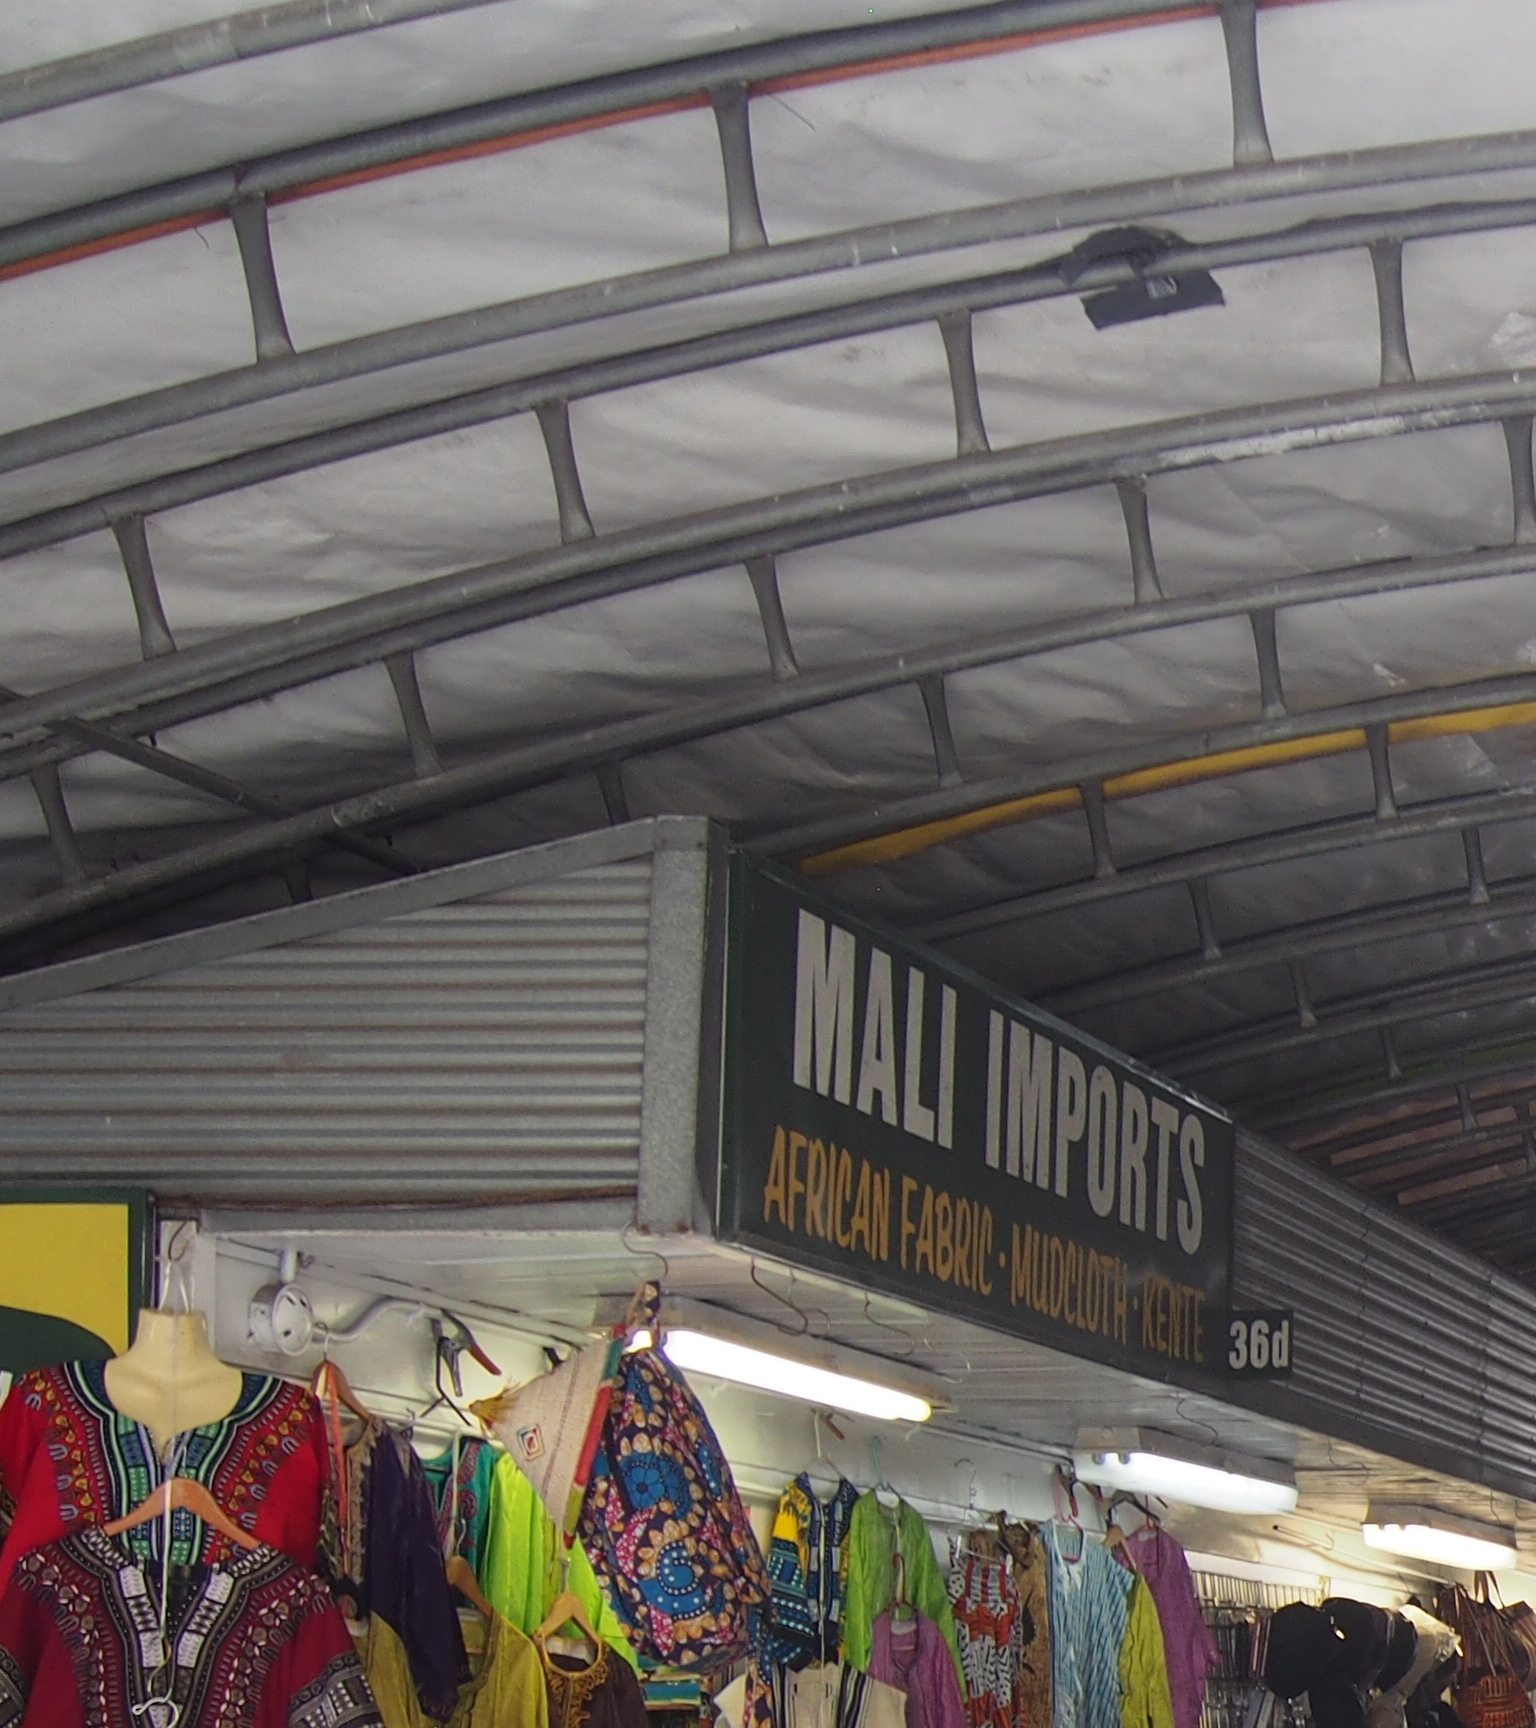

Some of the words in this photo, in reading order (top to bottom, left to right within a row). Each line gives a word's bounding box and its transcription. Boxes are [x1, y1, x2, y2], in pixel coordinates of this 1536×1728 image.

[794, 907, 957, 1150] MALI
[985, 1008, 1205, 1256] IMPORTS
[763, 1124, 891, 1262] AFRICAN
[901, 1175, 994, 1297] FABRIC
[1011, 1223, 1128, 1346] MUDCLOTH
[1142, 1268, 1205, 1364] KENTE
[1228, 1318, 1289, 1370] 36d
